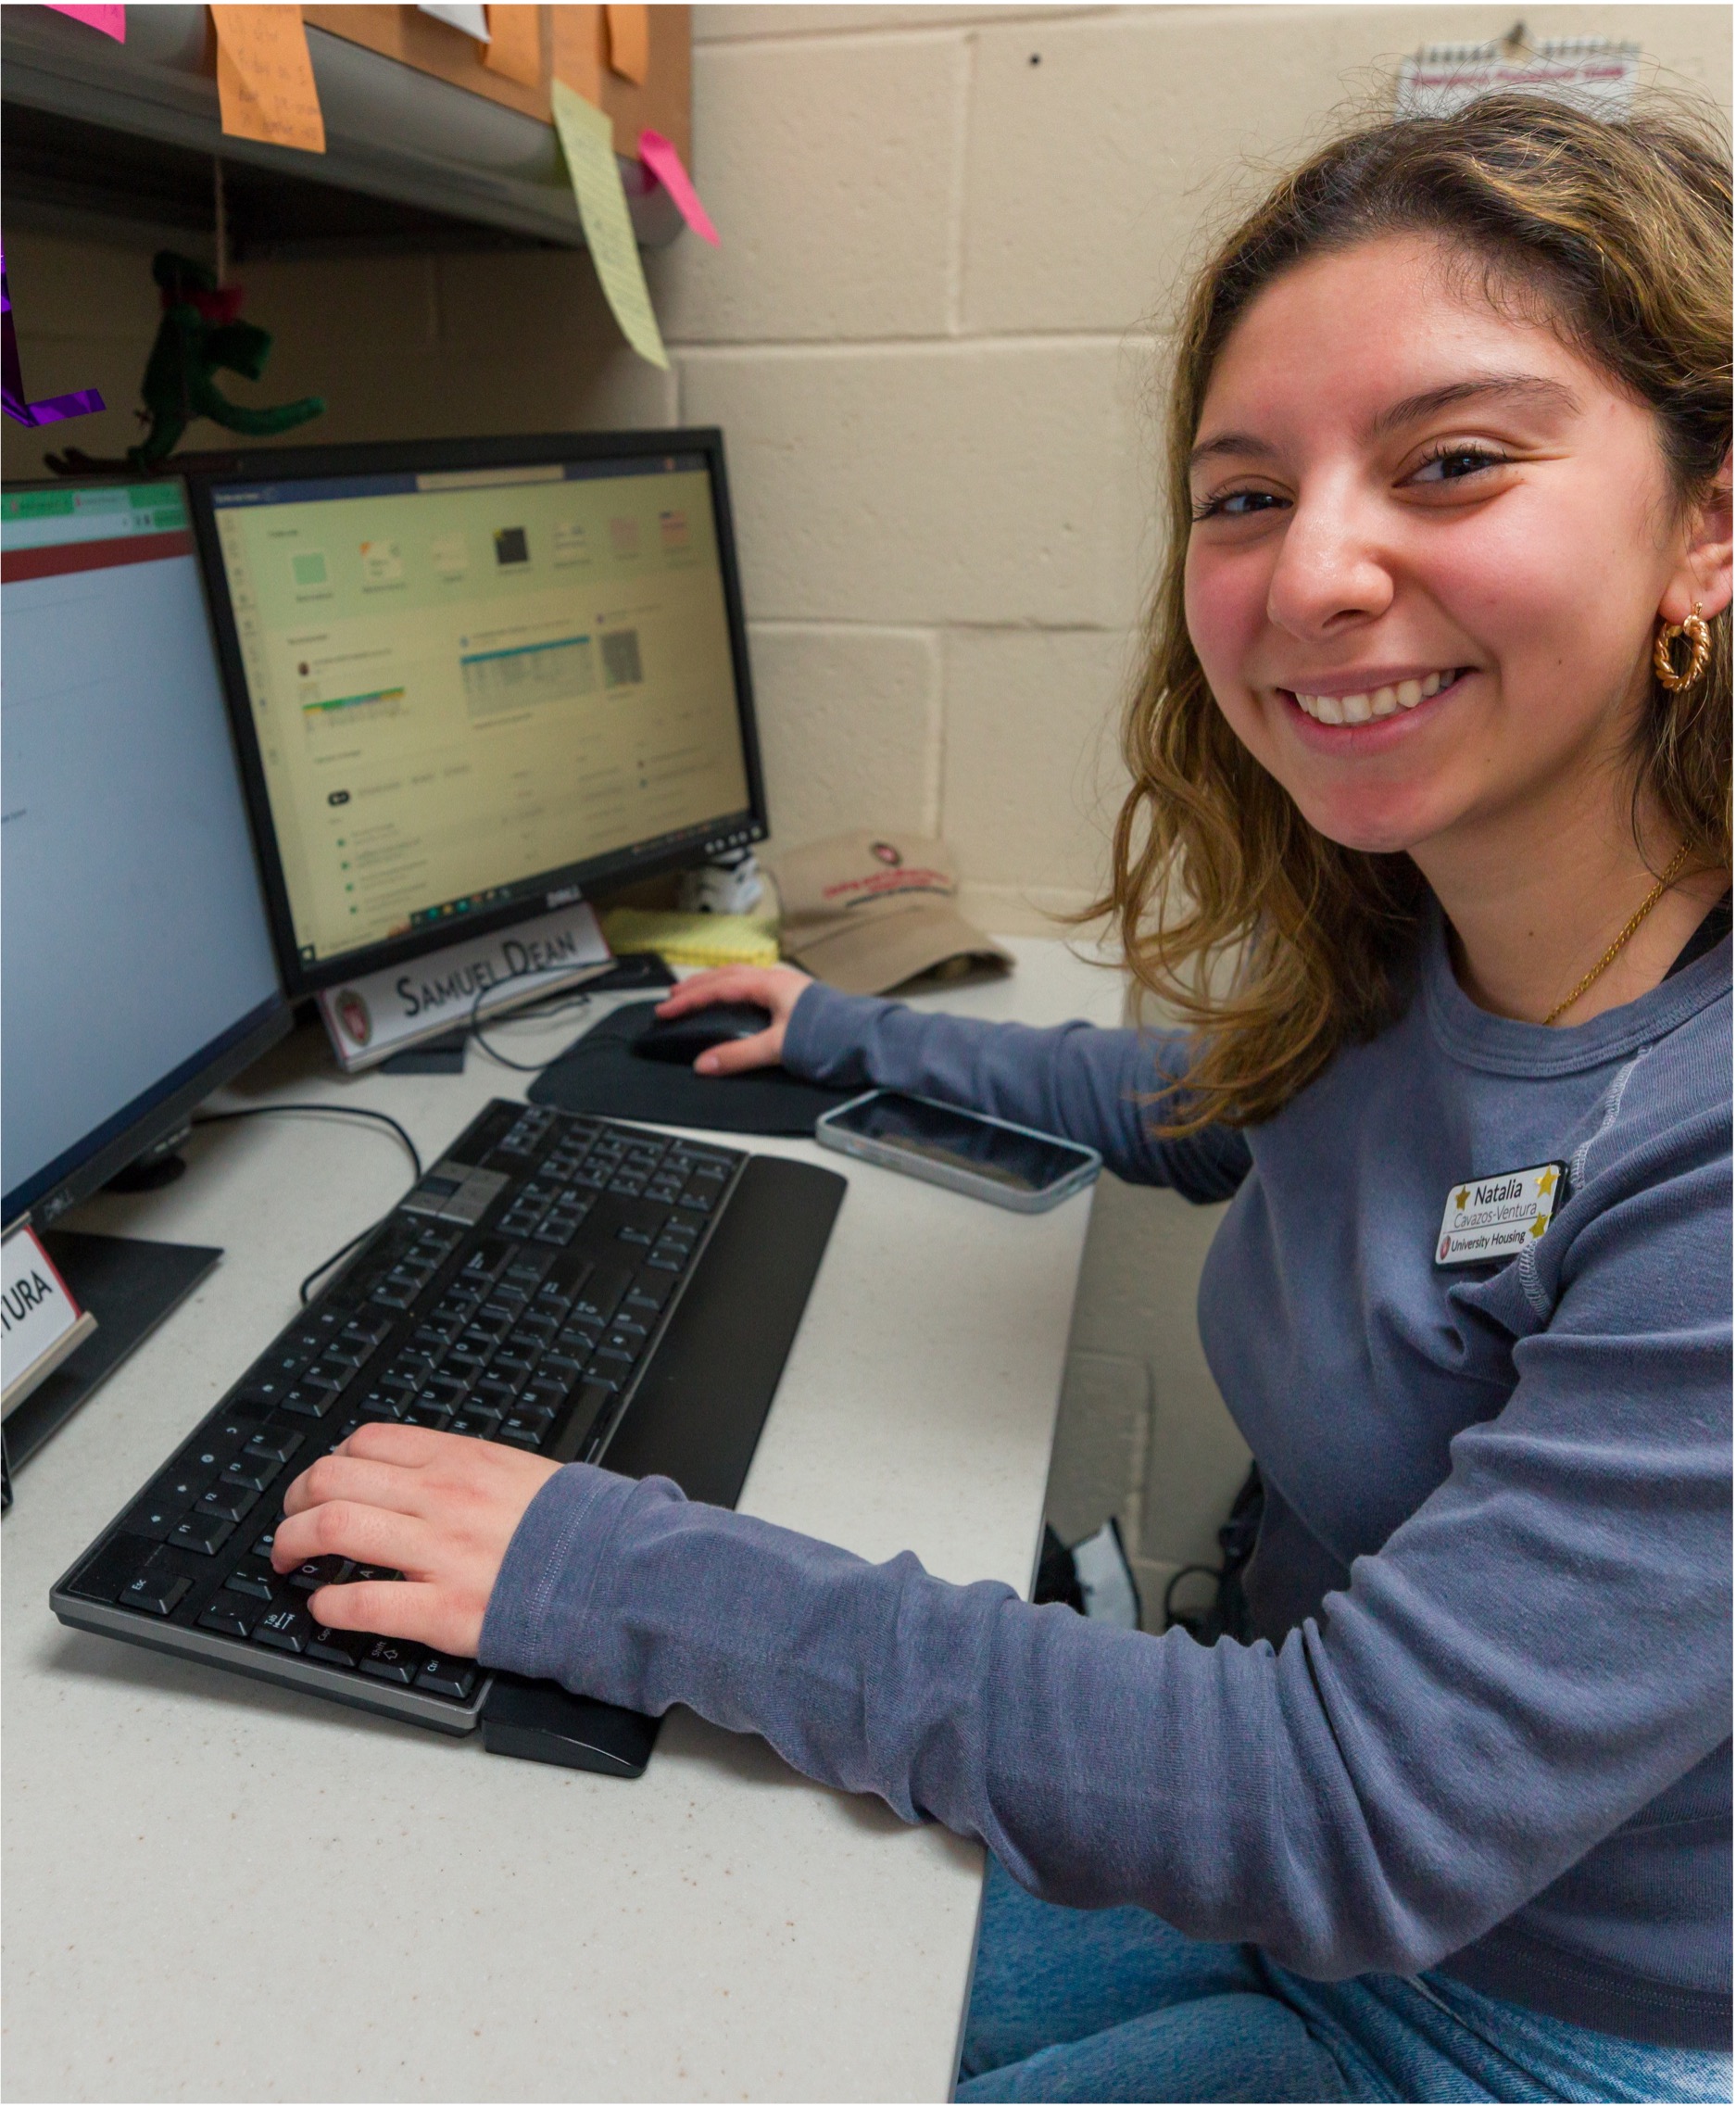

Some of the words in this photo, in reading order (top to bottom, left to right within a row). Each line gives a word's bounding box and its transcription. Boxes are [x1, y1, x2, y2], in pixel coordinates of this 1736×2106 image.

[396, 961, 496, 1016] SAMUEL
[502, 930, 577, 975] DEAN
[1474, 1179, 1523, 1206] Natalia
[1453, 1203, 1537, 1229] Cavazos-Ventura
[1451, 1235, 1490, 1252] University
[1491, 1230, 1527, 1247] Housing
[205, 1493, 218, 1501] F2
[178, 1524, 191, 1532] F1
[301, 1564, 319, 1574] Q
[359, 1570, 374, 1579] A
[132, 1579, 147, 1591] Esc
[264, 1614, 278, 1625] Tab
[371, 1641, 386, 1658] Shift
[426, 1660, 439, 1671] Ctrl
